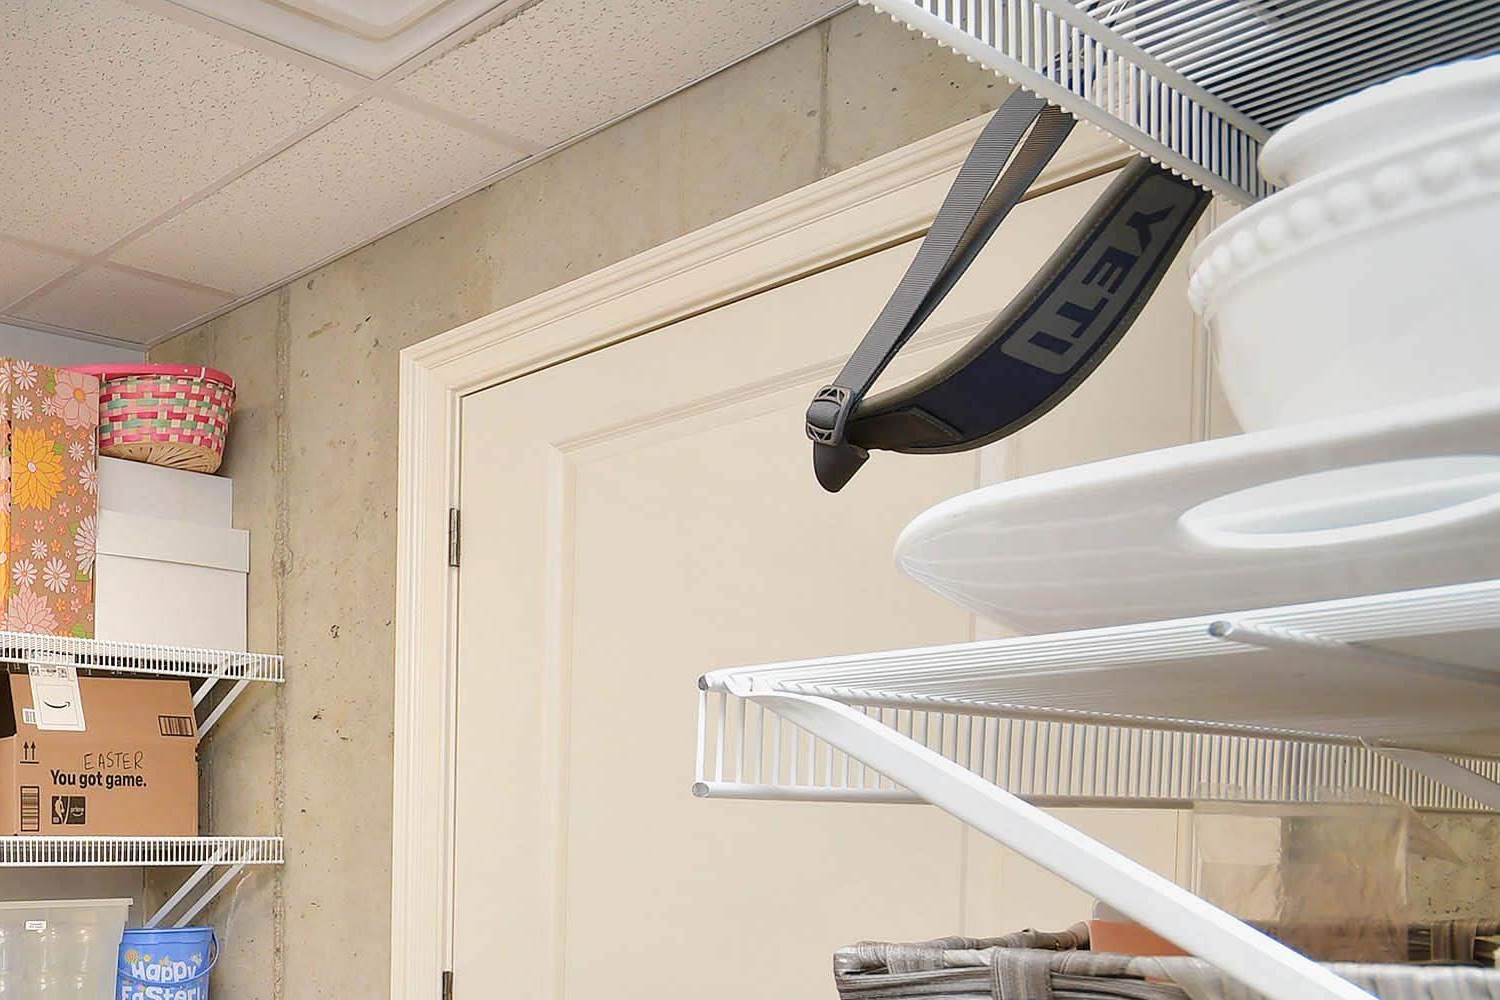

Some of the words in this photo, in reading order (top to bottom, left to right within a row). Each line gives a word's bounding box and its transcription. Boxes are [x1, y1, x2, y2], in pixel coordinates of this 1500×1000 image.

[1027, 203, 1177, 355] YETI
[84, 751, 143, 770] EASTER
[51, 769, 76, 785] You
[79, 772, 102, 789] got
[106, 775, 147, 789] game.
[131, 961, 197, 983] Happy
